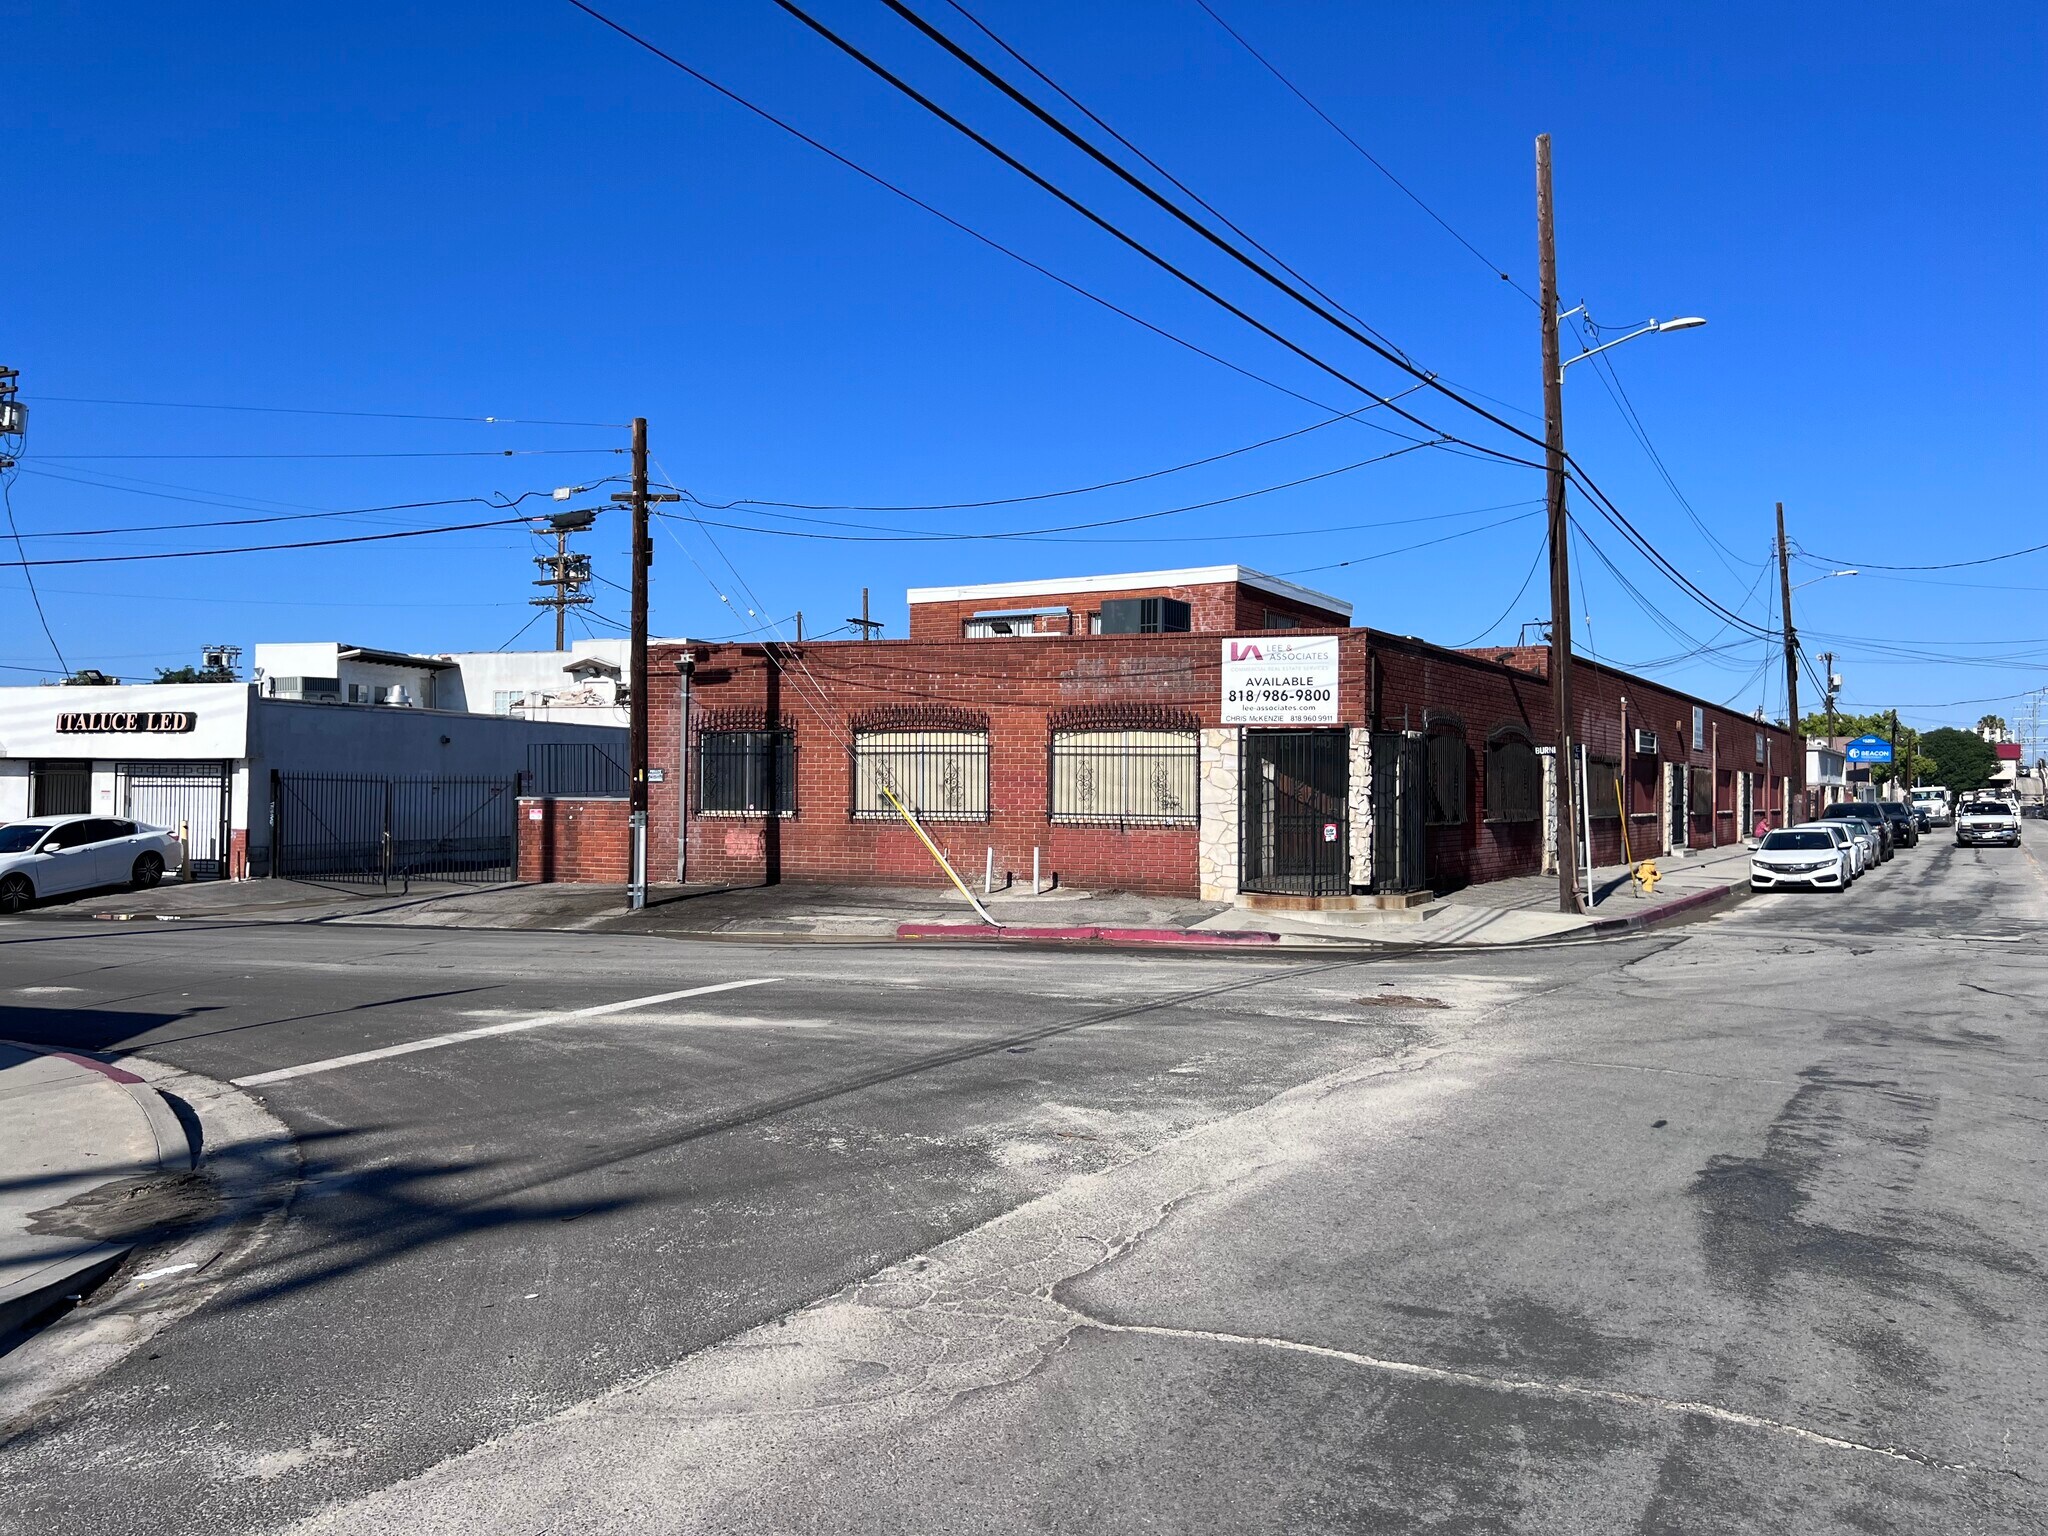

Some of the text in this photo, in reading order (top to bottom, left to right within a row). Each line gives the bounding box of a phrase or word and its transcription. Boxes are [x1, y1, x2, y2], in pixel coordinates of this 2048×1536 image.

[1269, 652, 1329, 661] ASSOCIATES
[1246, 677, 1314, 686] AVAILABLE
[1228, 689, 1331, 703] 818/986-9800
[56, 712, 188, 731] ITALUCE LED
